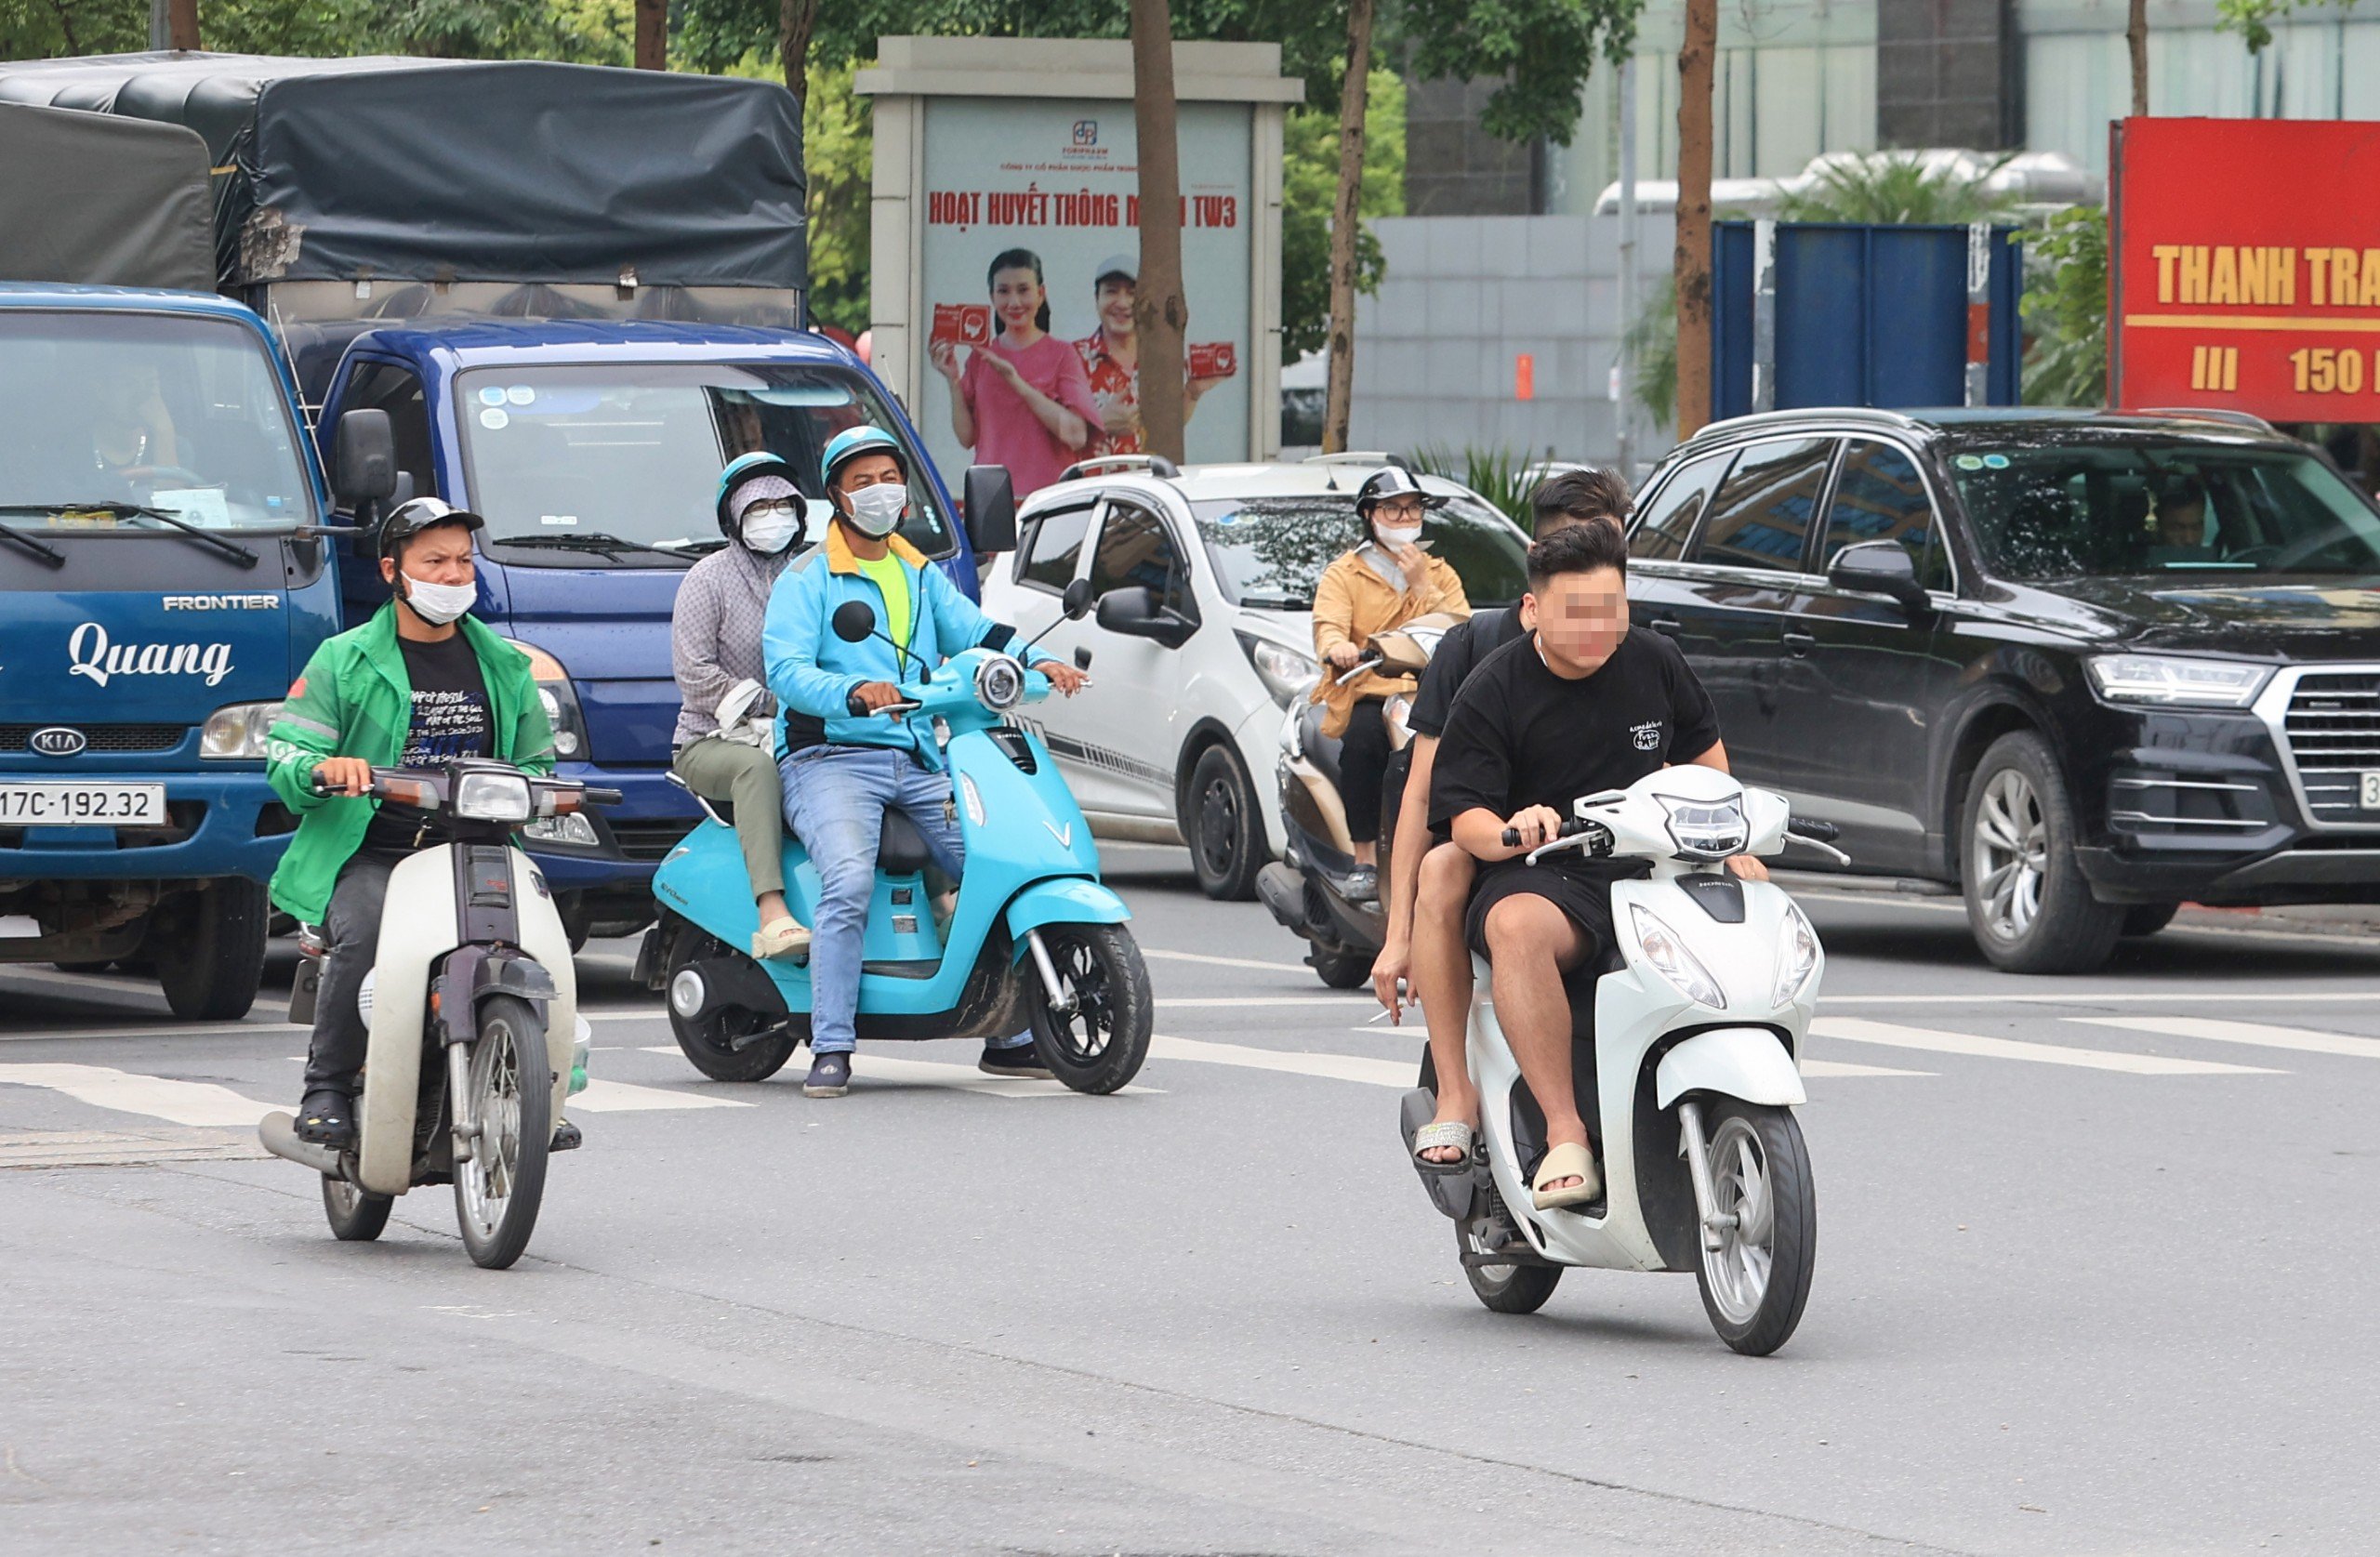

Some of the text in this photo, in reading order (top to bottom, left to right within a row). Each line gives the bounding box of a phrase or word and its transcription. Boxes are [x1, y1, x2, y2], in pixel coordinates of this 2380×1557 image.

[930, 191, 981, 232] HOẠT
[987, 181, 1049, 225] HUYẾT
[1053, 188, 1118, 227] THÔNG
[1193, 195, 1236, 228] TW3
[2152, 244, 2296, 306] THANH
[2289, 348, 2364, 394] 150
[163, 595, 279, 611] FRONTIER
[69, 622, 234, 688] Quang
[41, 734, 77, 749] KIA
[0, 791, 149, 817] 17C-192.32
